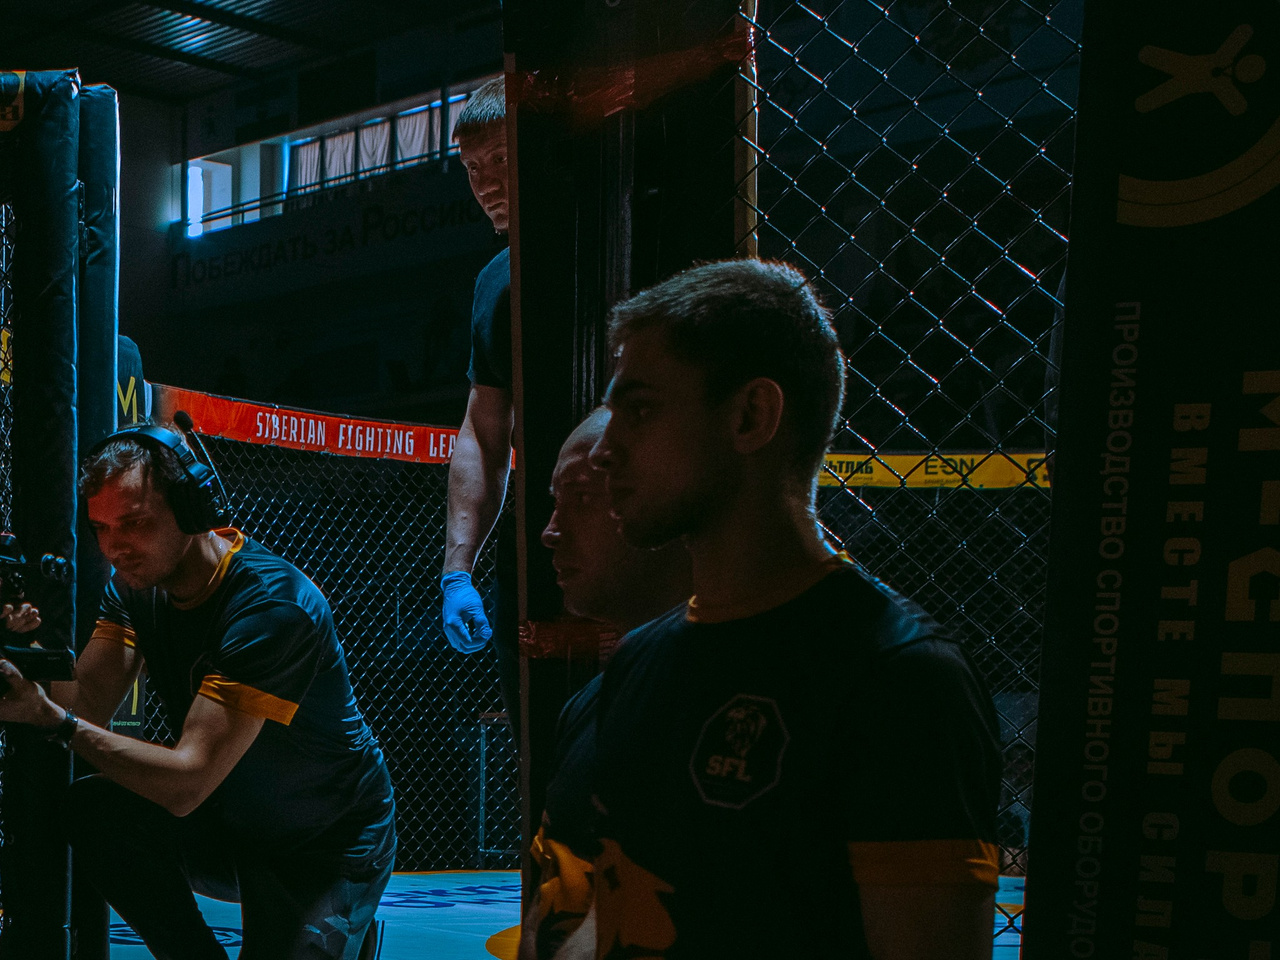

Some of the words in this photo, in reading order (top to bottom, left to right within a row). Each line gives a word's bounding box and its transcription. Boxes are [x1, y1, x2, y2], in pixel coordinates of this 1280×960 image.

[255, 412, 327, 446] SIBERIAN
[337, 422, 416, 456] FIGHTING
[1098, 301, 1142, 560] ПРОИЗВОДСТВО
[1157, 402, 1213, 641] ВМЕСТЕ
[1081, 568, 1124, 802] СПОРТИВНОГО
[1147, 678, 1191, 775] МЫ
[705, 754, 753, 783] SFL
